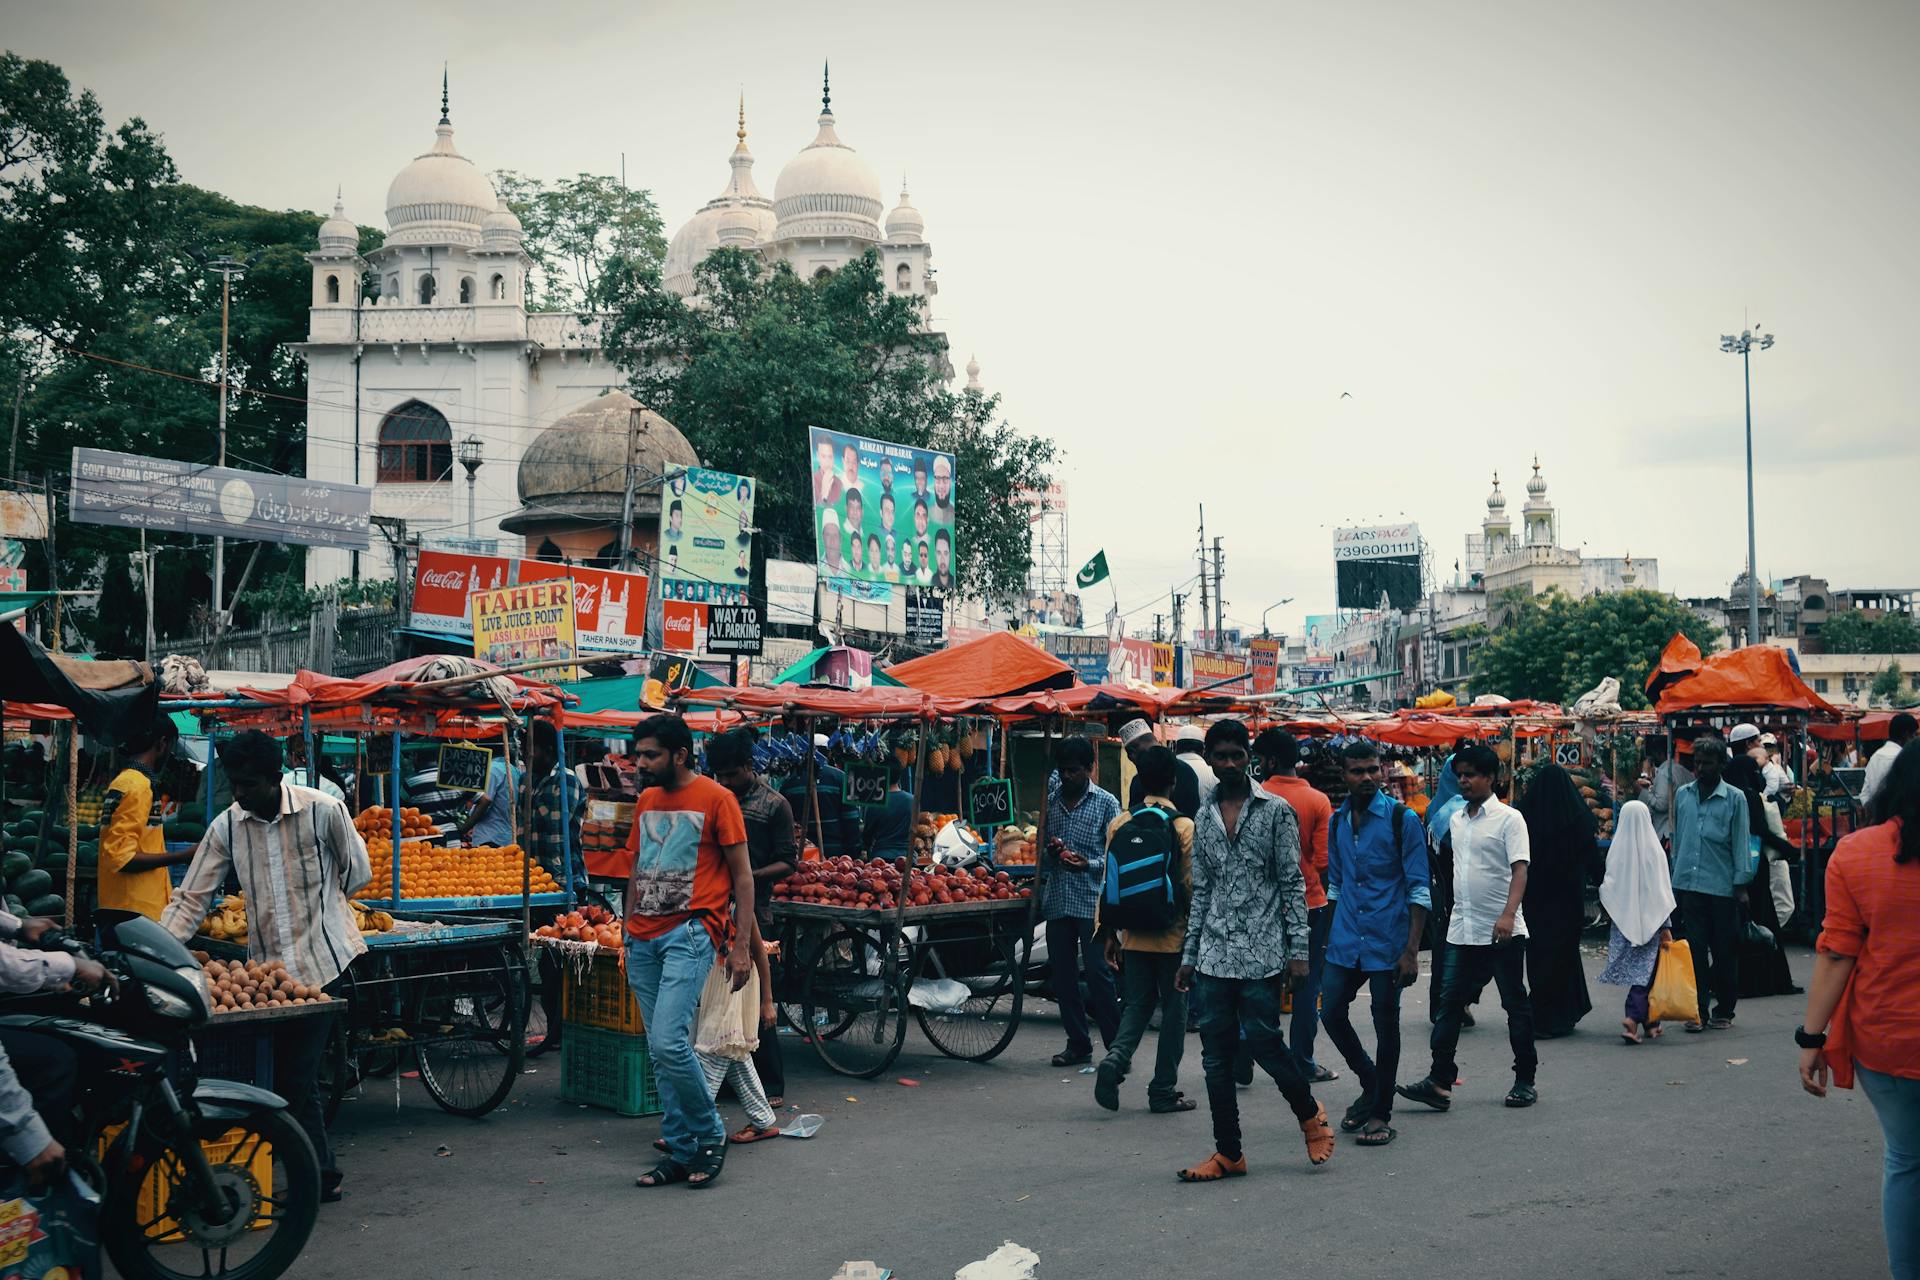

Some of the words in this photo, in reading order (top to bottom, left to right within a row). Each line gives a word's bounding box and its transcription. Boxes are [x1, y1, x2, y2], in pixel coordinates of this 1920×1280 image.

[860, 440, 884, 454] RAMZAN
[884, 445, 913, 460] MUBARAK
[82, 462, 105, 477] GOVT
[106, 466, 141, 481] NIZAMIA
[142, 471, 178, 487] GENERAL
[179, 475, 217, 492] HOSPITAL
[1333, 542, 1415, 558] 7396001111
[422, 568, 466, 590] Coca-Cola
[476, 583, 568, 616] TAHER
[481, 615, 502, 632] LIVE
[504, 611, 531, 629] JUICE
[535, 607, 564, 625] POINT
[665, 615, 692, 632] Coca-Cola
[714, 607, 738, 624] WAY
[741, 608, 757, 624] TO
[488, 629, 512, 644] LASSI
[515, 629, 521, 641] &
[523, 625, 558, 639] FALUDA
[582, 633, 604, 644] TAHER
[605, 636, 618, 645] PAN
[618, 636, 637, 647] SHOP
[1555, 743, 1580, 764] 60
